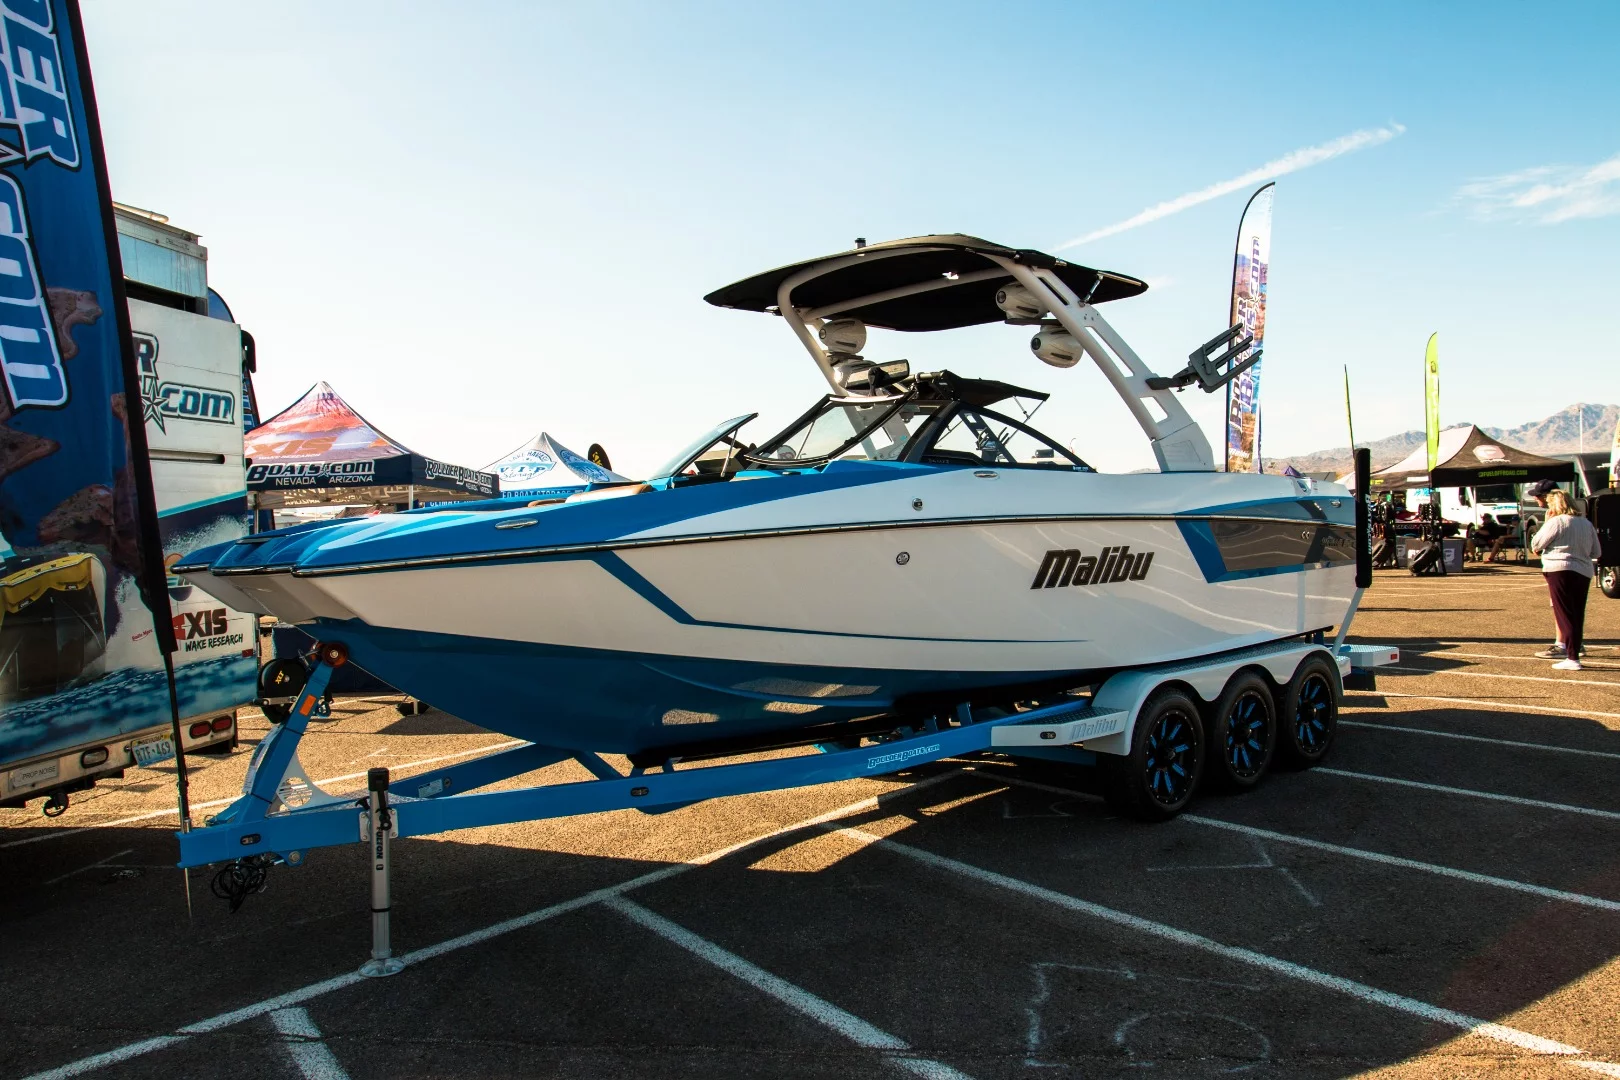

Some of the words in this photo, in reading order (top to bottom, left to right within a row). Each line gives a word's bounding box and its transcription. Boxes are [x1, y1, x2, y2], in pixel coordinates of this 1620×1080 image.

[275, 476, 316, 486] NEVADA
[328, 475, 373, 484] ARIZONA
[1030, 546, 1155, 590] Malibu
[185, 639, 207, 652] WAKE
[208, 634, 243, 648] RESEARCH
[1069, 719, 1118, 740] Malibu
[38, 766, 56, 777] NOISE
